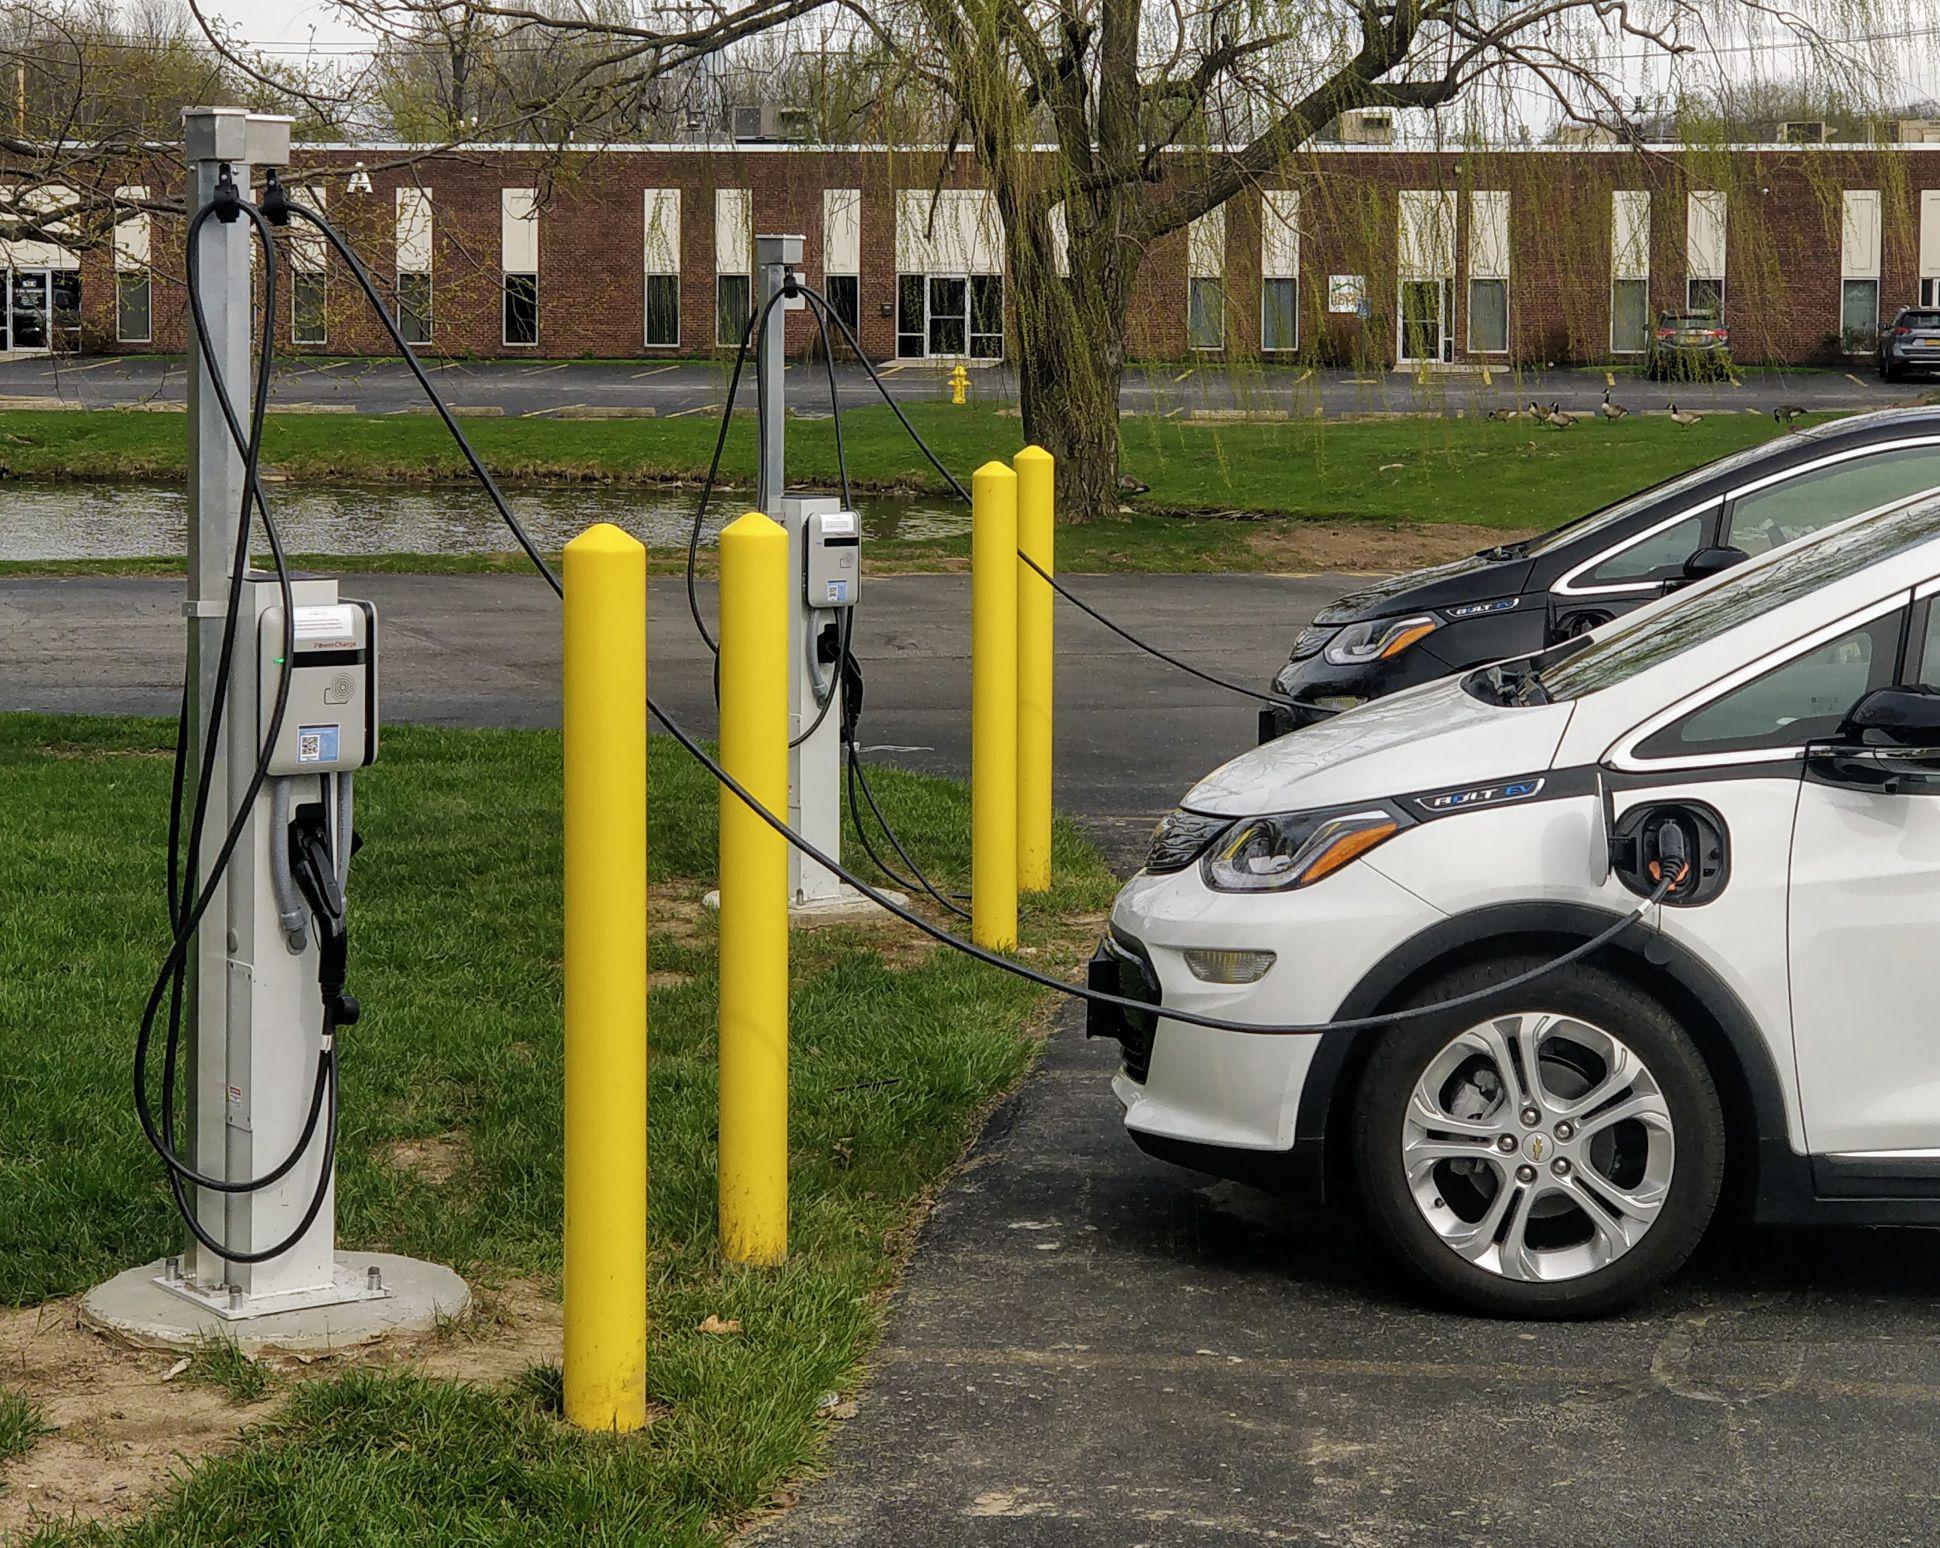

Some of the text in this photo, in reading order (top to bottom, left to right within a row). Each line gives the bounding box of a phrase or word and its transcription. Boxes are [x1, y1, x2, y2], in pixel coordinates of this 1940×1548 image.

[346, 161, 374, 193] A
[1433, 783, 1535, 807] BOLT EV
